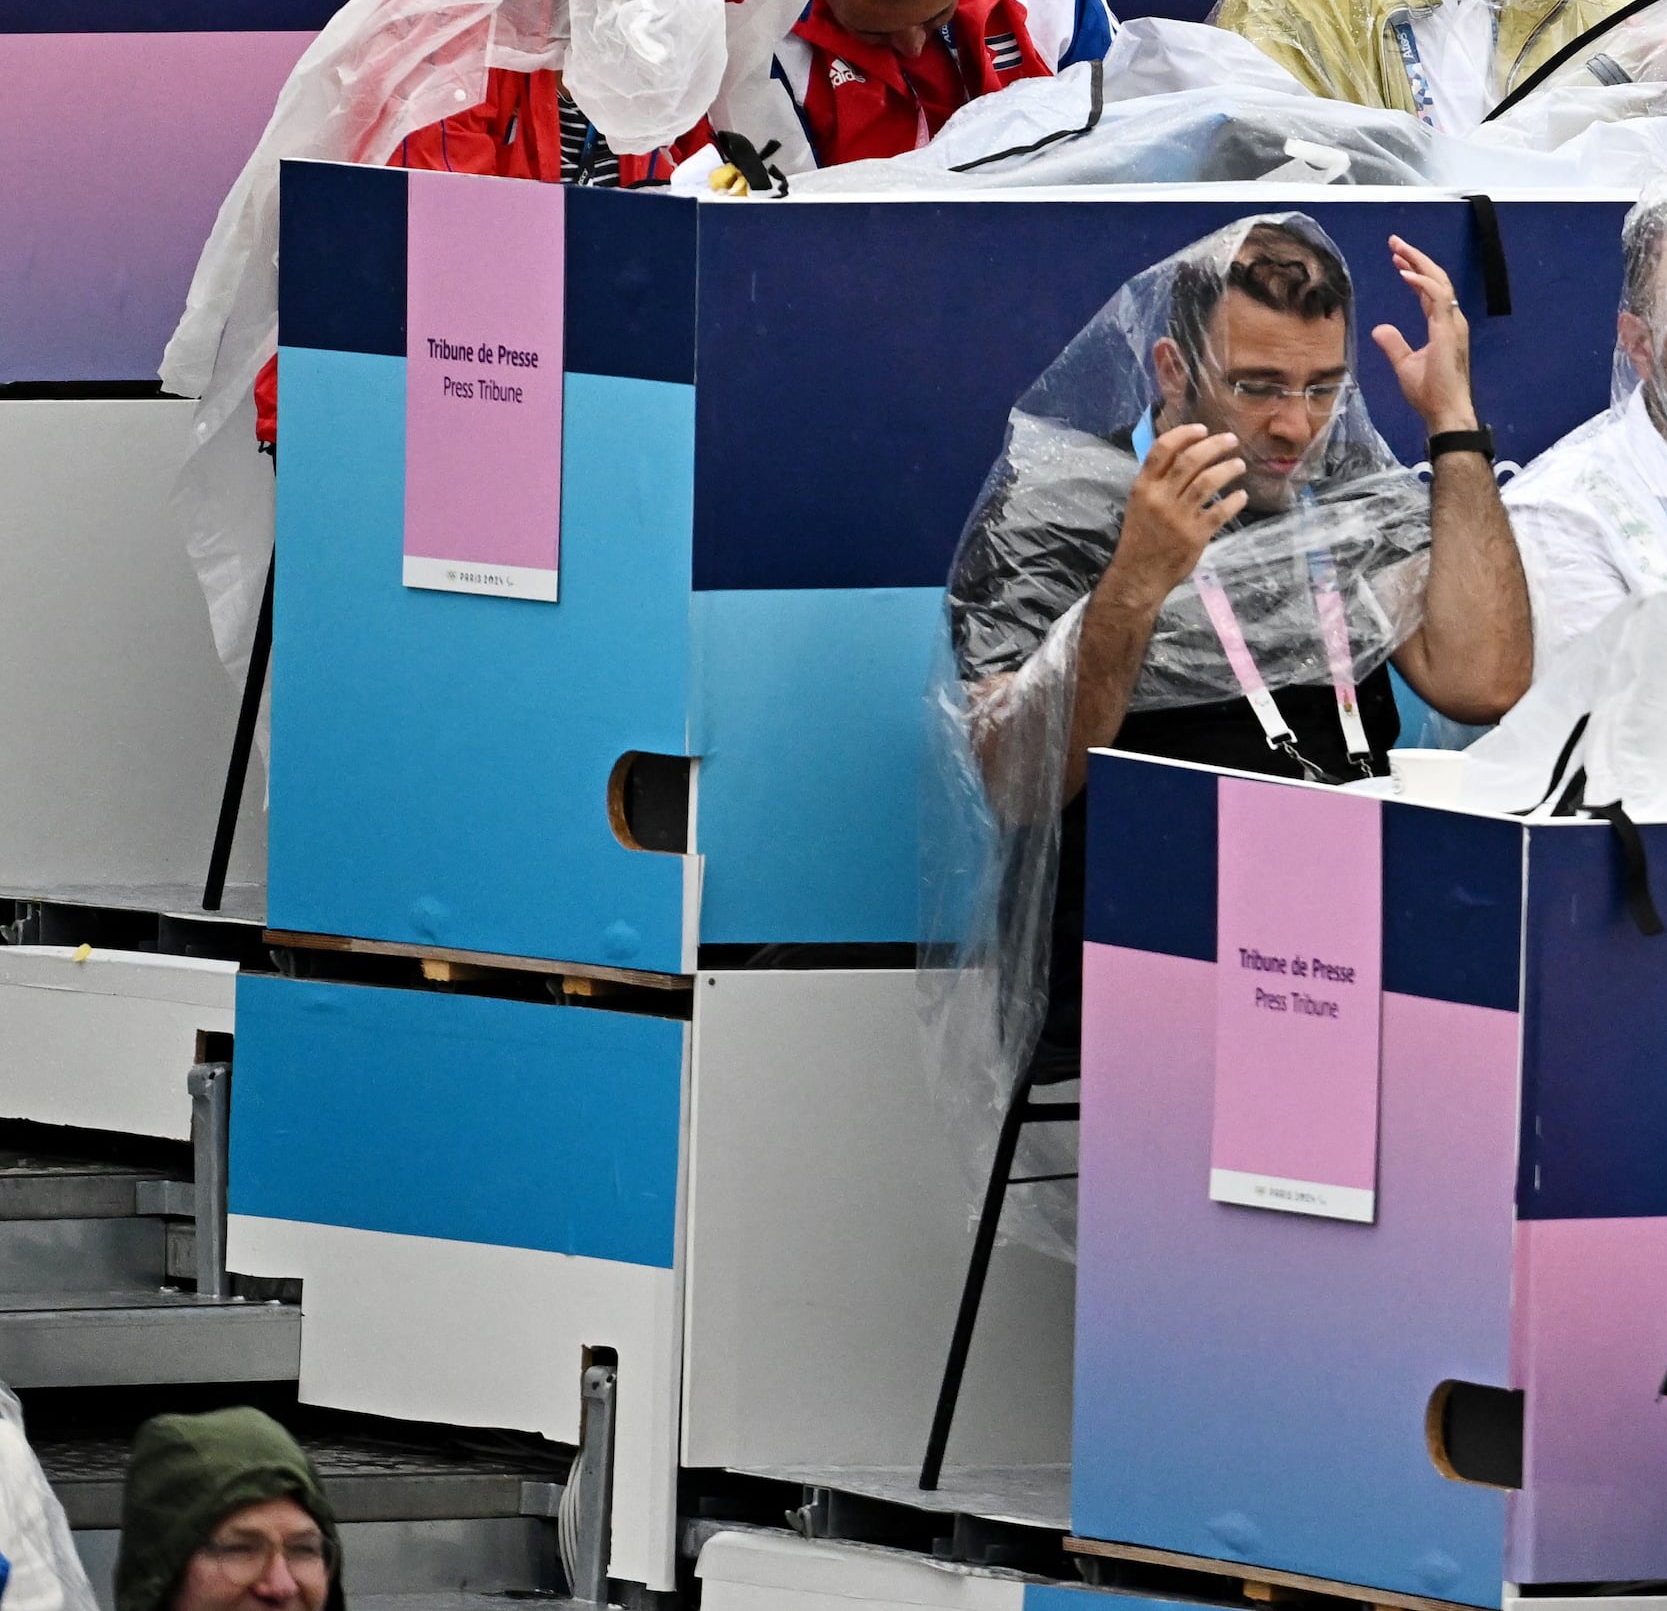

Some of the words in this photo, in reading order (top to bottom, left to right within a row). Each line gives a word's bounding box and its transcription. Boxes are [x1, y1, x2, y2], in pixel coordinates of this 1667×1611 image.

[1400, 32, 1414, 59] Atos
[426, 338, 474, 363] Tribune
[477, 346, 494, 365] de
[498, 347, 539, 369] Presse
[444, 377, 473, 399] Press
[479, 380, 523, 404] Tribune
[1240, 949, 1287, 975] Tribune
[1291, 956, 1308, 977] de
[1312, 959, 1355, 984] Presse
[1256, 987, 1287, 1011] Press
[1291, 992, 1339, 1018] Tribune
